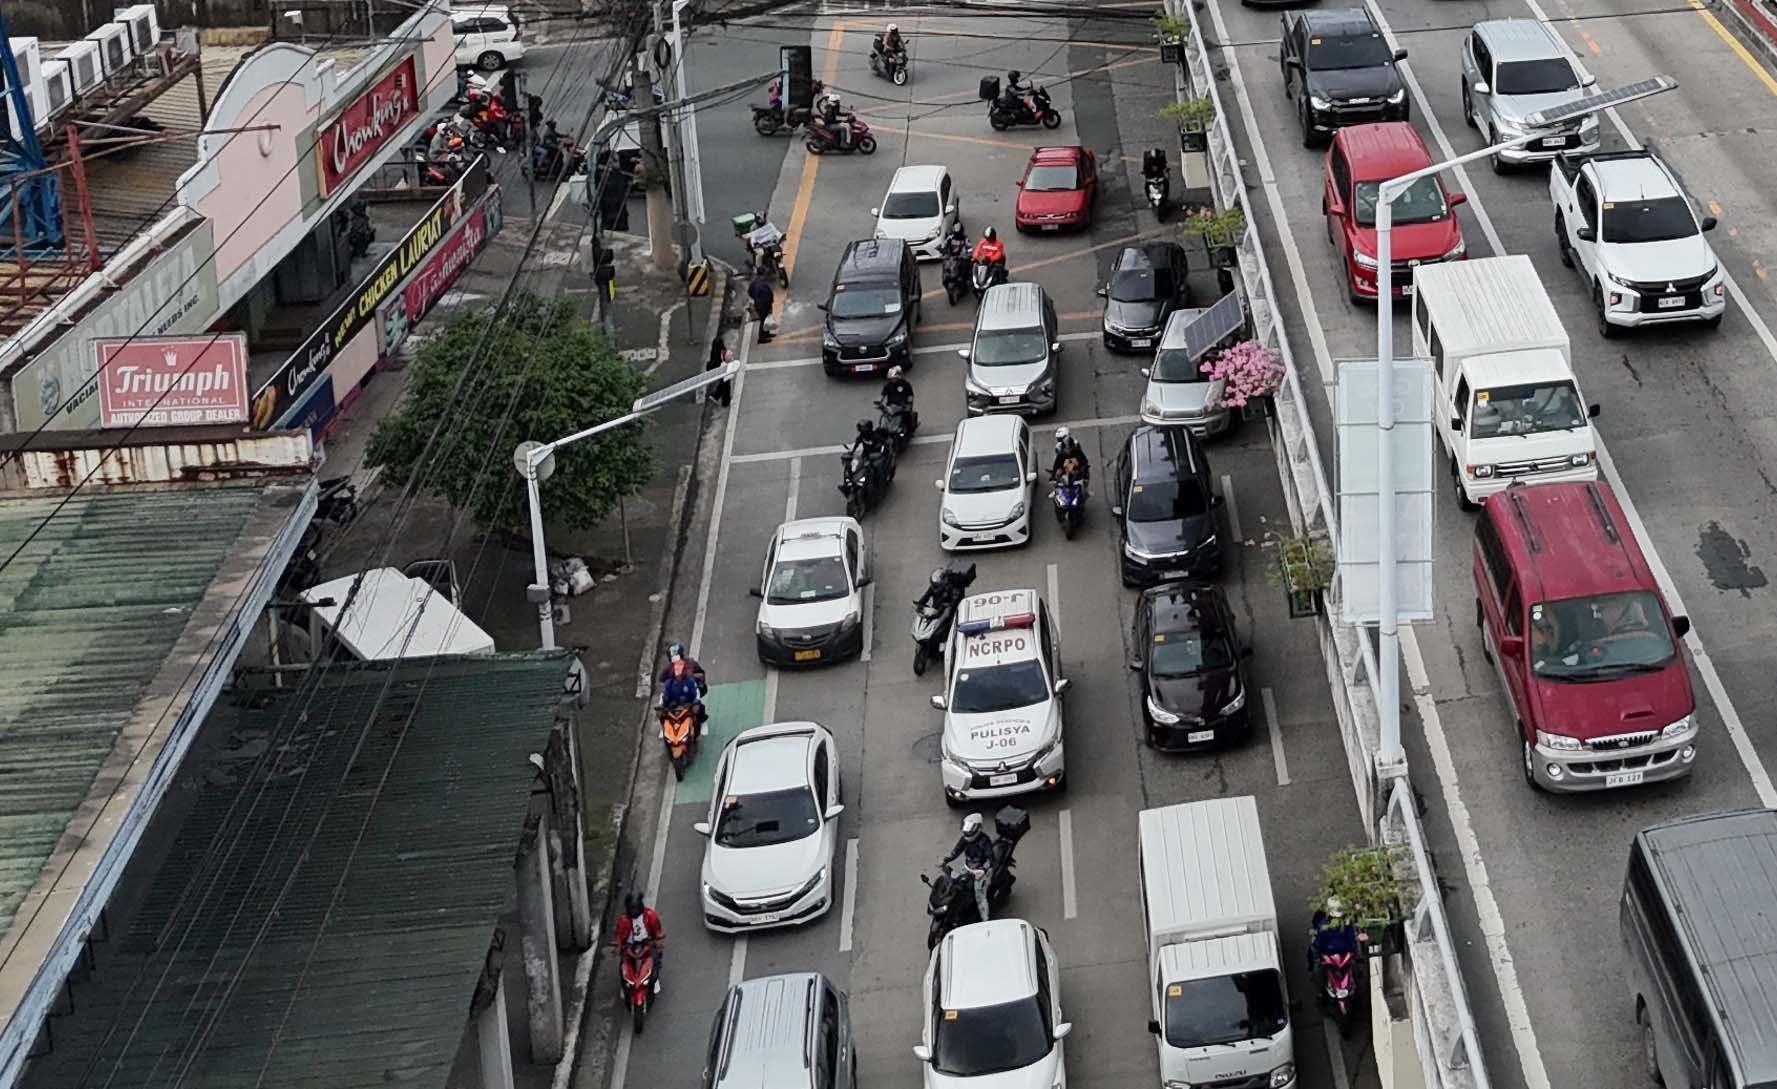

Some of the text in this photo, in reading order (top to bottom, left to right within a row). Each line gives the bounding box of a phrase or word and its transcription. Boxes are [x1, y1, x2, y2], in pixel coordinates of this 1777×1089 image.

[333, 89, 403, 175] Chowking
[359, 259, 398, 318] CHICKEN
[400, 207, 442, 276] LAURIAT
[156, 304, 183, 336] NEEDS
[115, 364, 230, 396] Triumph
[122, 397, 226, 407] INTERNATIONAL
[110, 412, 168, 425] AUTHORIZED
[206, 408, 241, 421] DEALER
[968, 637, 1026, 658] NCRPO
[970, 726, 1031, 741] PULISYA
[985, 737, 1017, 750] J-06
